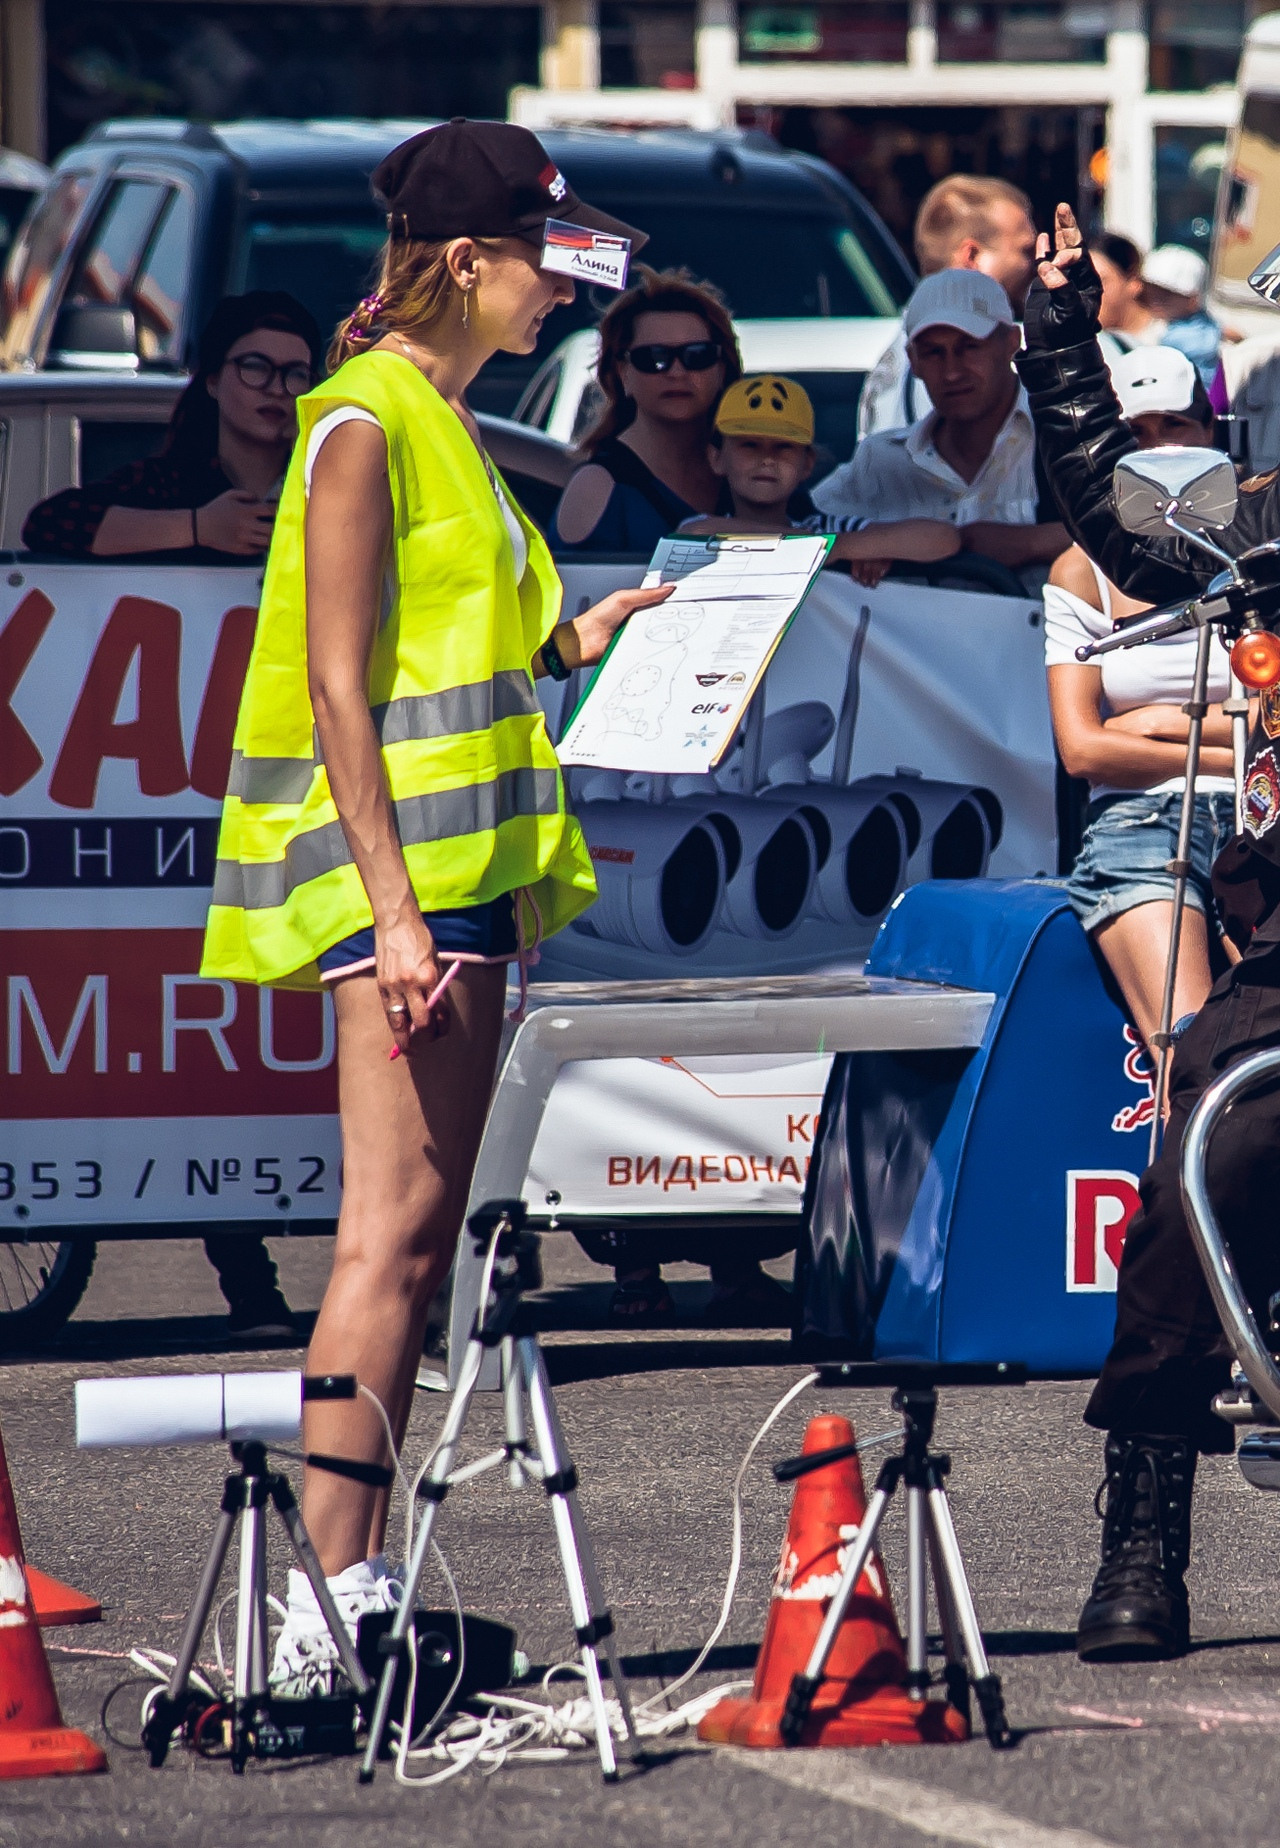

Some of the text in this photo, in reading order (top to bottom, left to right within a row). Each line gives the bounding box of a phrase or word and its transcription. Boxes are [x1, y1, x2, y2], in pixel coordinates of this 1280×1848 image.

[571, 252, 619, 276] Алина
[690, 702, 719, 715] elf
[786, 1113, 822, 1143] К
[608, 1155, 812, 1192] ВИДЕОНА
